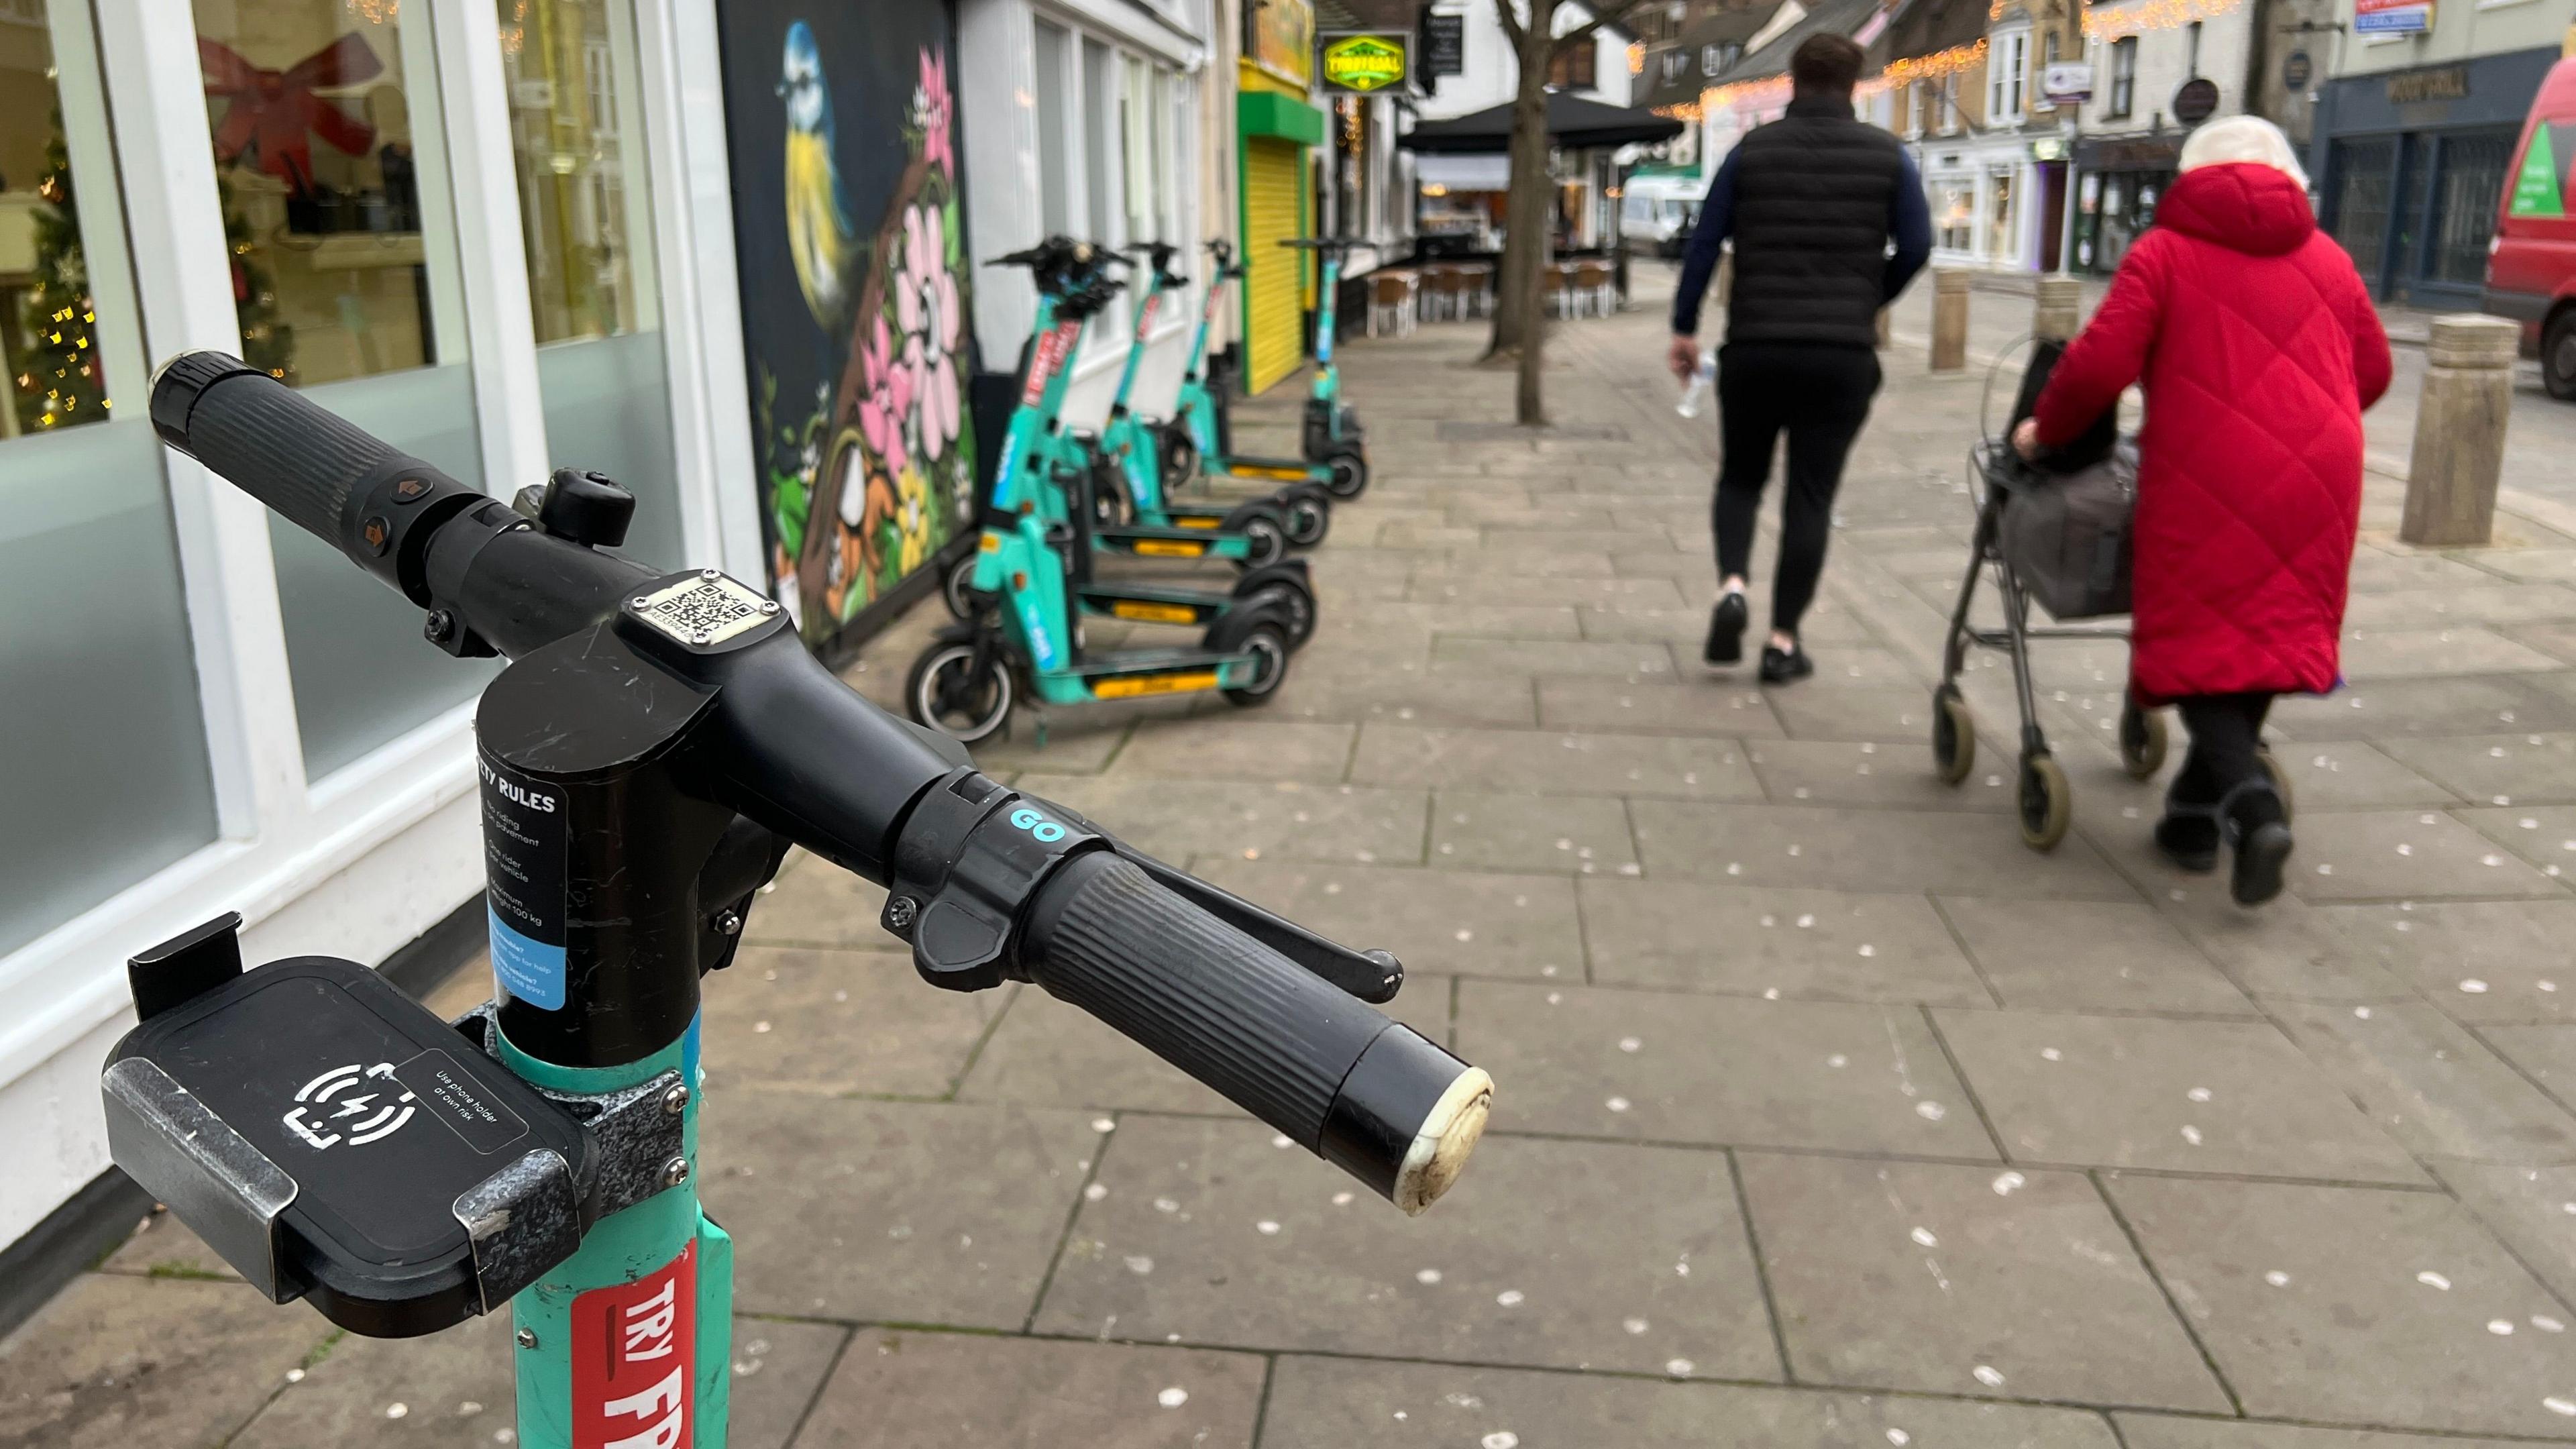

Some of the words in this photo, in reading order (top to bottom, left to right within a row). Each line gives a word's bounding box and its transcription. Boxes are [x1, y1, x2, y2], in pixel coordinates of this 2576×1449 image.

[498, 776, 555, 813] RULES
[496, 810, 521, 831] riding
[496, 820, 540, 847] pavement
[1010, 809, 1066, 843] GO
[499, 860, 529, 883] vehicle
[502, 853, 522, 869] rider
[490, 875, 523, 908] Maximum
[512, 906, 528, 920] 100
[530, 913, 543, 927] kg
[434, 1087, 445, 1096] at
[442, 1095, 460, 1110] own
[458, 1108, 474, 1122] risk
[436, 1070, 451, 1085] Use
[447, 1083, 474, 1104] phone
[472, 1100, 498, 1124] holder
[625, 1277, 675, 1362] TRY
